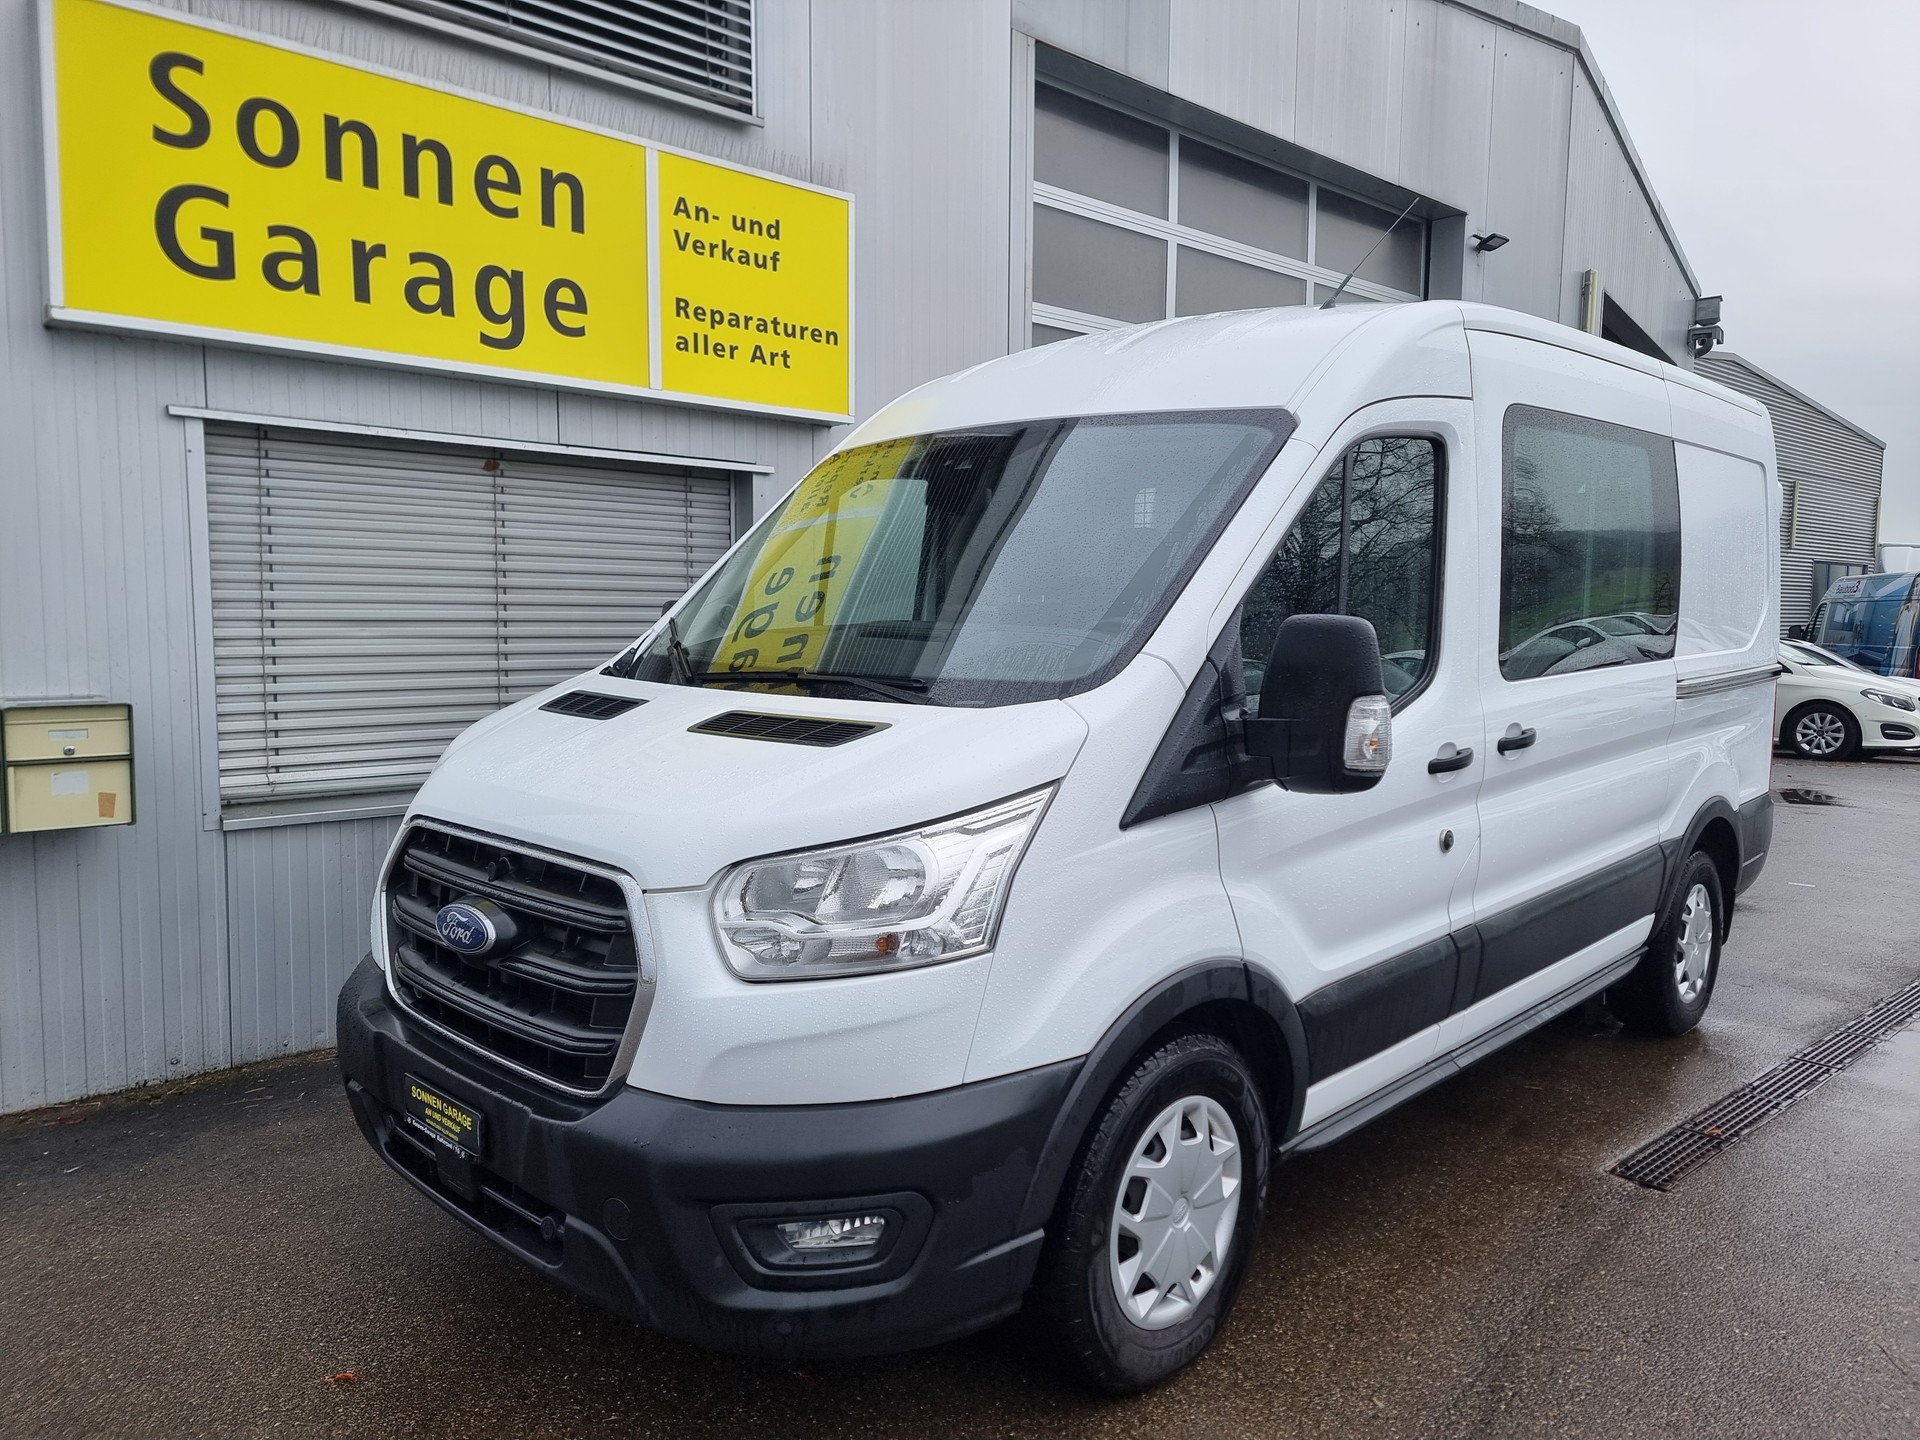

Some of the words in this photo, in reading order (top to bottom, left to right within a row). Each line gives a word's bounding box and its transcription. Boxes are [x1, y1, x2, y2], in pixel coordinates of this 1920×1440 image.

[149, 52, 585, 234] Sonnen
[673, 196, 720, 224] An-
[731, 214, 781, 241] und
[154, 184, 588, 350] Garage
[673, 229, 781, 272] Verkauf
[675, 297, 839, 346] Reparaturen
[675, 332, 739, 360] aller
[750, 344, 791, 369] Art
[442, 911, 475, 944] Ford
[411, 1085, 442, 1111] SONNEN
[442, 1103, 473, 1130] GARAGE
[424, 1107, 432, 1117] AN
